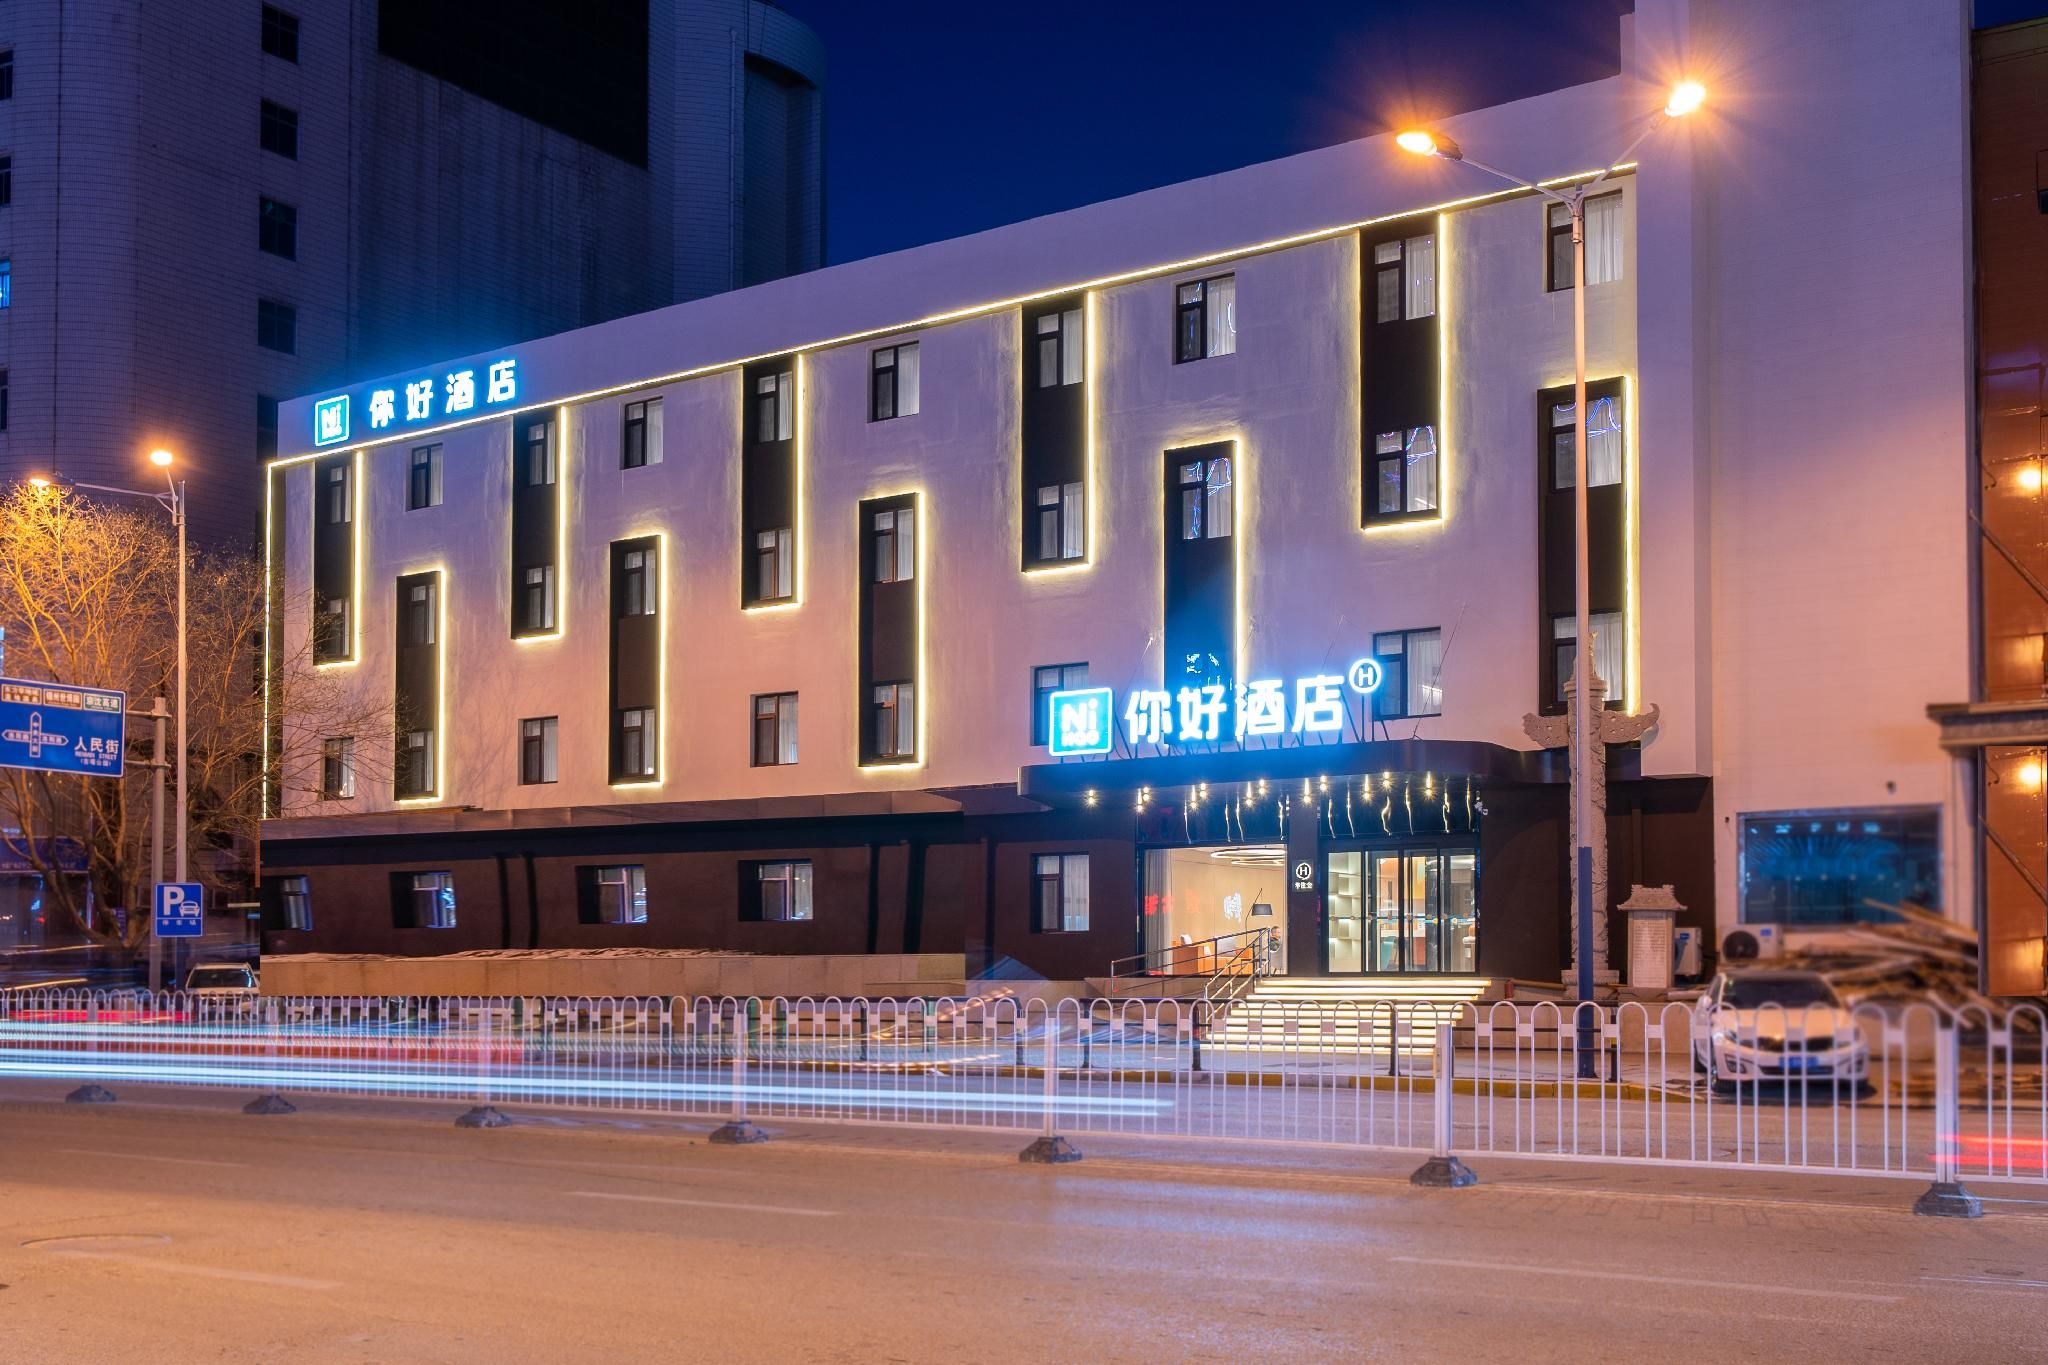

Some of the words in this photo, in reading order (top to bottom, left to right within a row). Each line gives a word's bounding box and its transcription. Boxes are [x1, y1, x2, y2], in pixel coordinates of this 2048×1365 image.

[369, 359, 517, 429] 你好酒店
[1061, 697, 1099, 733] Ni
[1124, 674, 1346, 744] 你好酒店
[74, 736, 119, 755] 人民街
[163, 886, 185, 916] P
